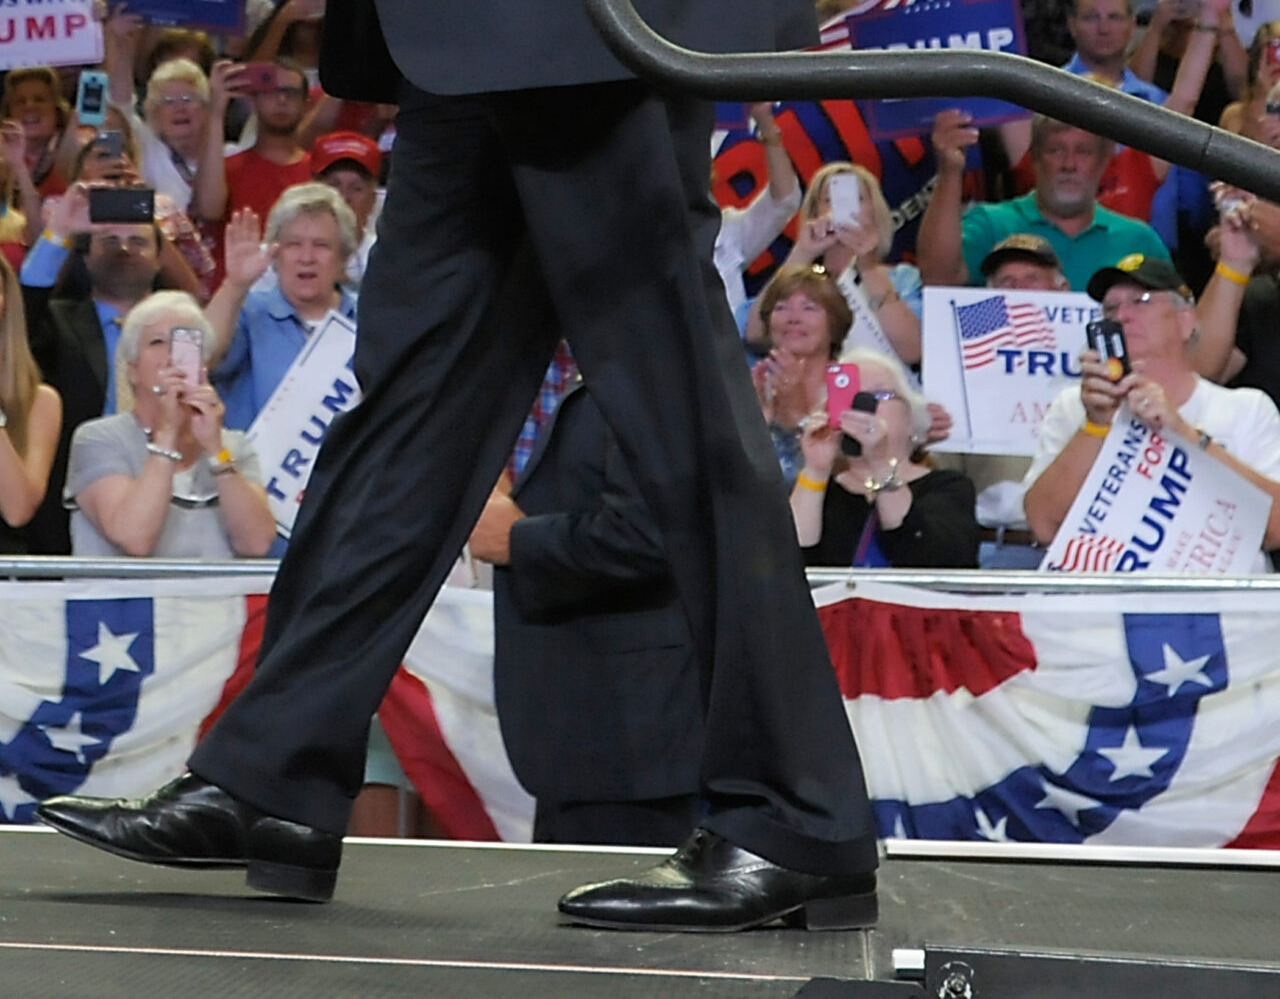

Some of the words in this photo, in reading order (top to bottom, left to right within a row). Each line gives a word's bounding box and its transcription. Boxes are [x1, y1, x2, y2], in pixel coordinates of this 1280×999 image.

[1045, 305, 1103, 324] VETE
[996, 349, 1083, 378] TRU
[266, 358, 356, 502] TRUM
[1136, 431, 1166, 480] FOR
[1078, 418, 1149, 536] VETERANS
[1115, 447, 1194, 572] RUMP
